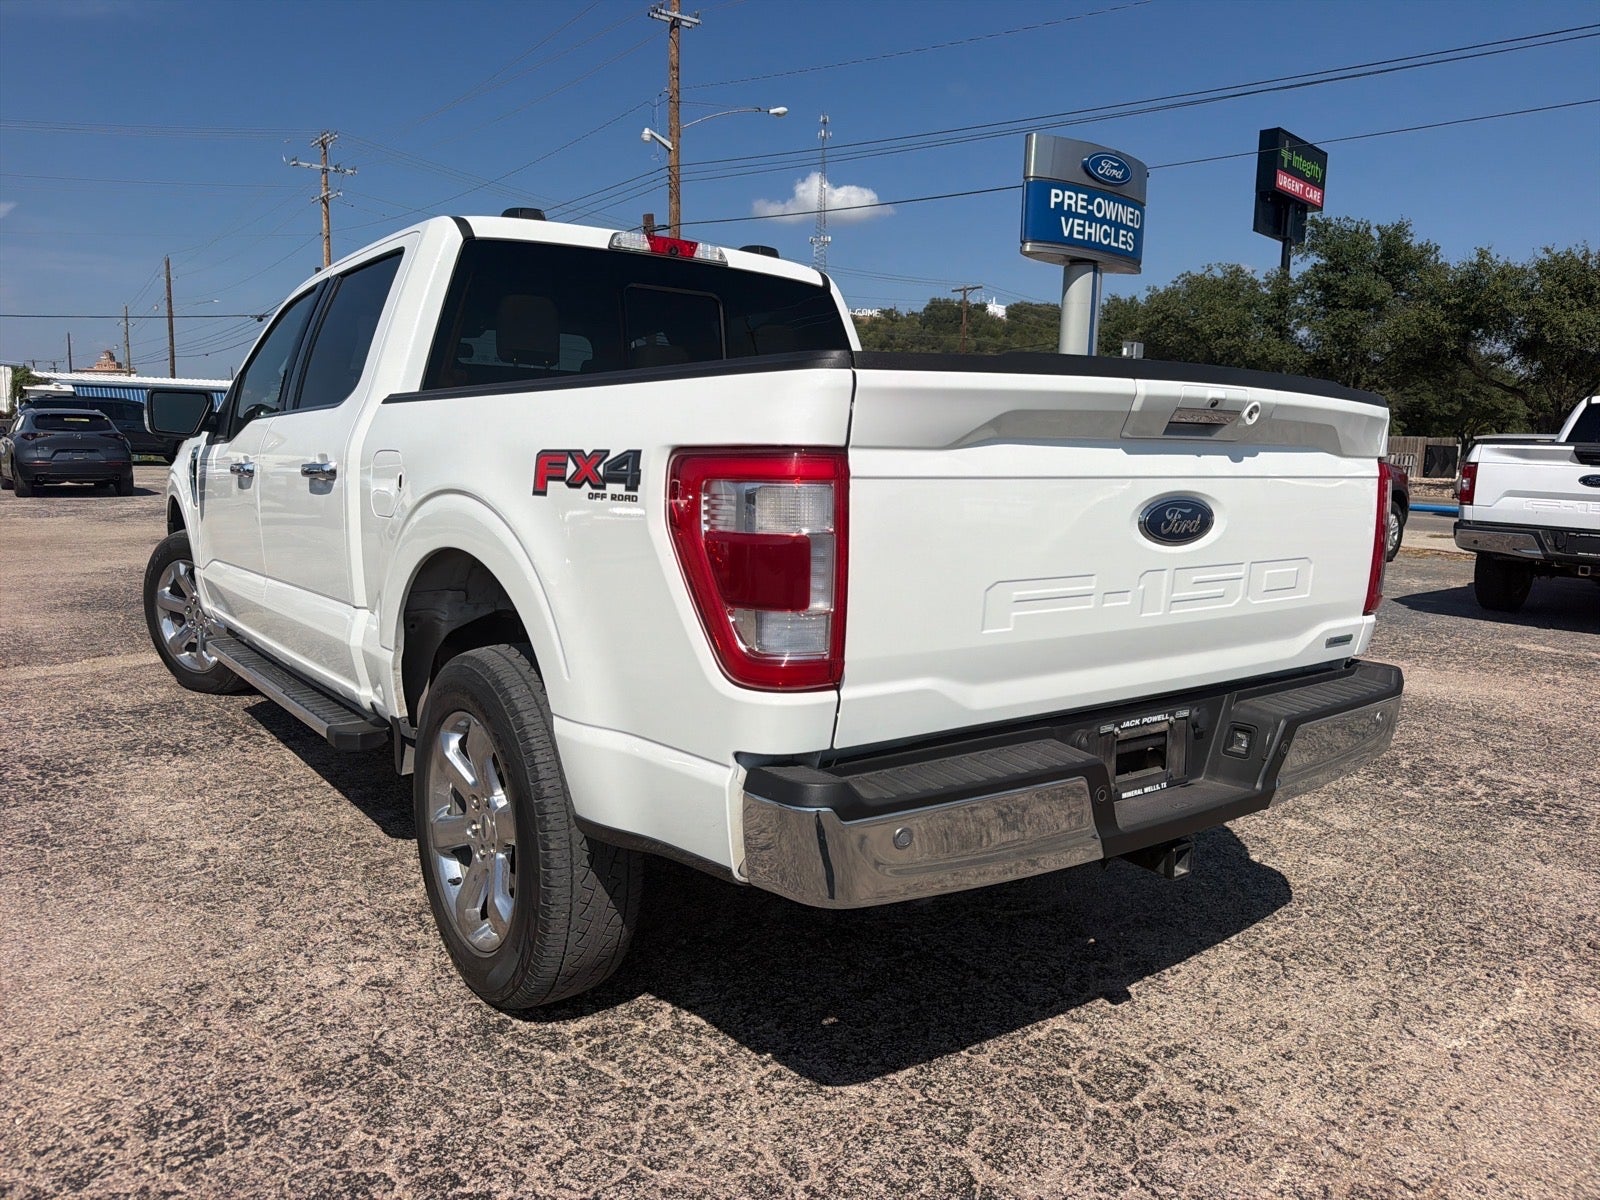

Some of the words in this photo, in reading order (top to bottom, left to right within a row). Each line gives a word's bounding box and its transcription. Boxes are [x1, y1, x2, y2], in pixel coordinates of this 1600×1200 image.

[1100, 157, 1124, 180] Ford
[1292, 151, 1324, 182] Integrity
[1278, 174, 1304, 195] URGENT
[1305, 186, 1321, 203] CARE
[1050, 188, 1141, 228] PRE-OWNED
[1061, 216, 1135, 252] VEHICLES
[532, 449, 643, 497] FX4
[588, 492, 607, 500] OFF
[610, 494, 638, 503] ROAD
[1161, 507, 1201, 535] Ford
[981, 557, 1313, 633] F-150
[1120, 718, 1141, 729] JACK
[1142, 713, 1170, 725] POWELL
[1122, 788, 1143, 799] MINERAL
